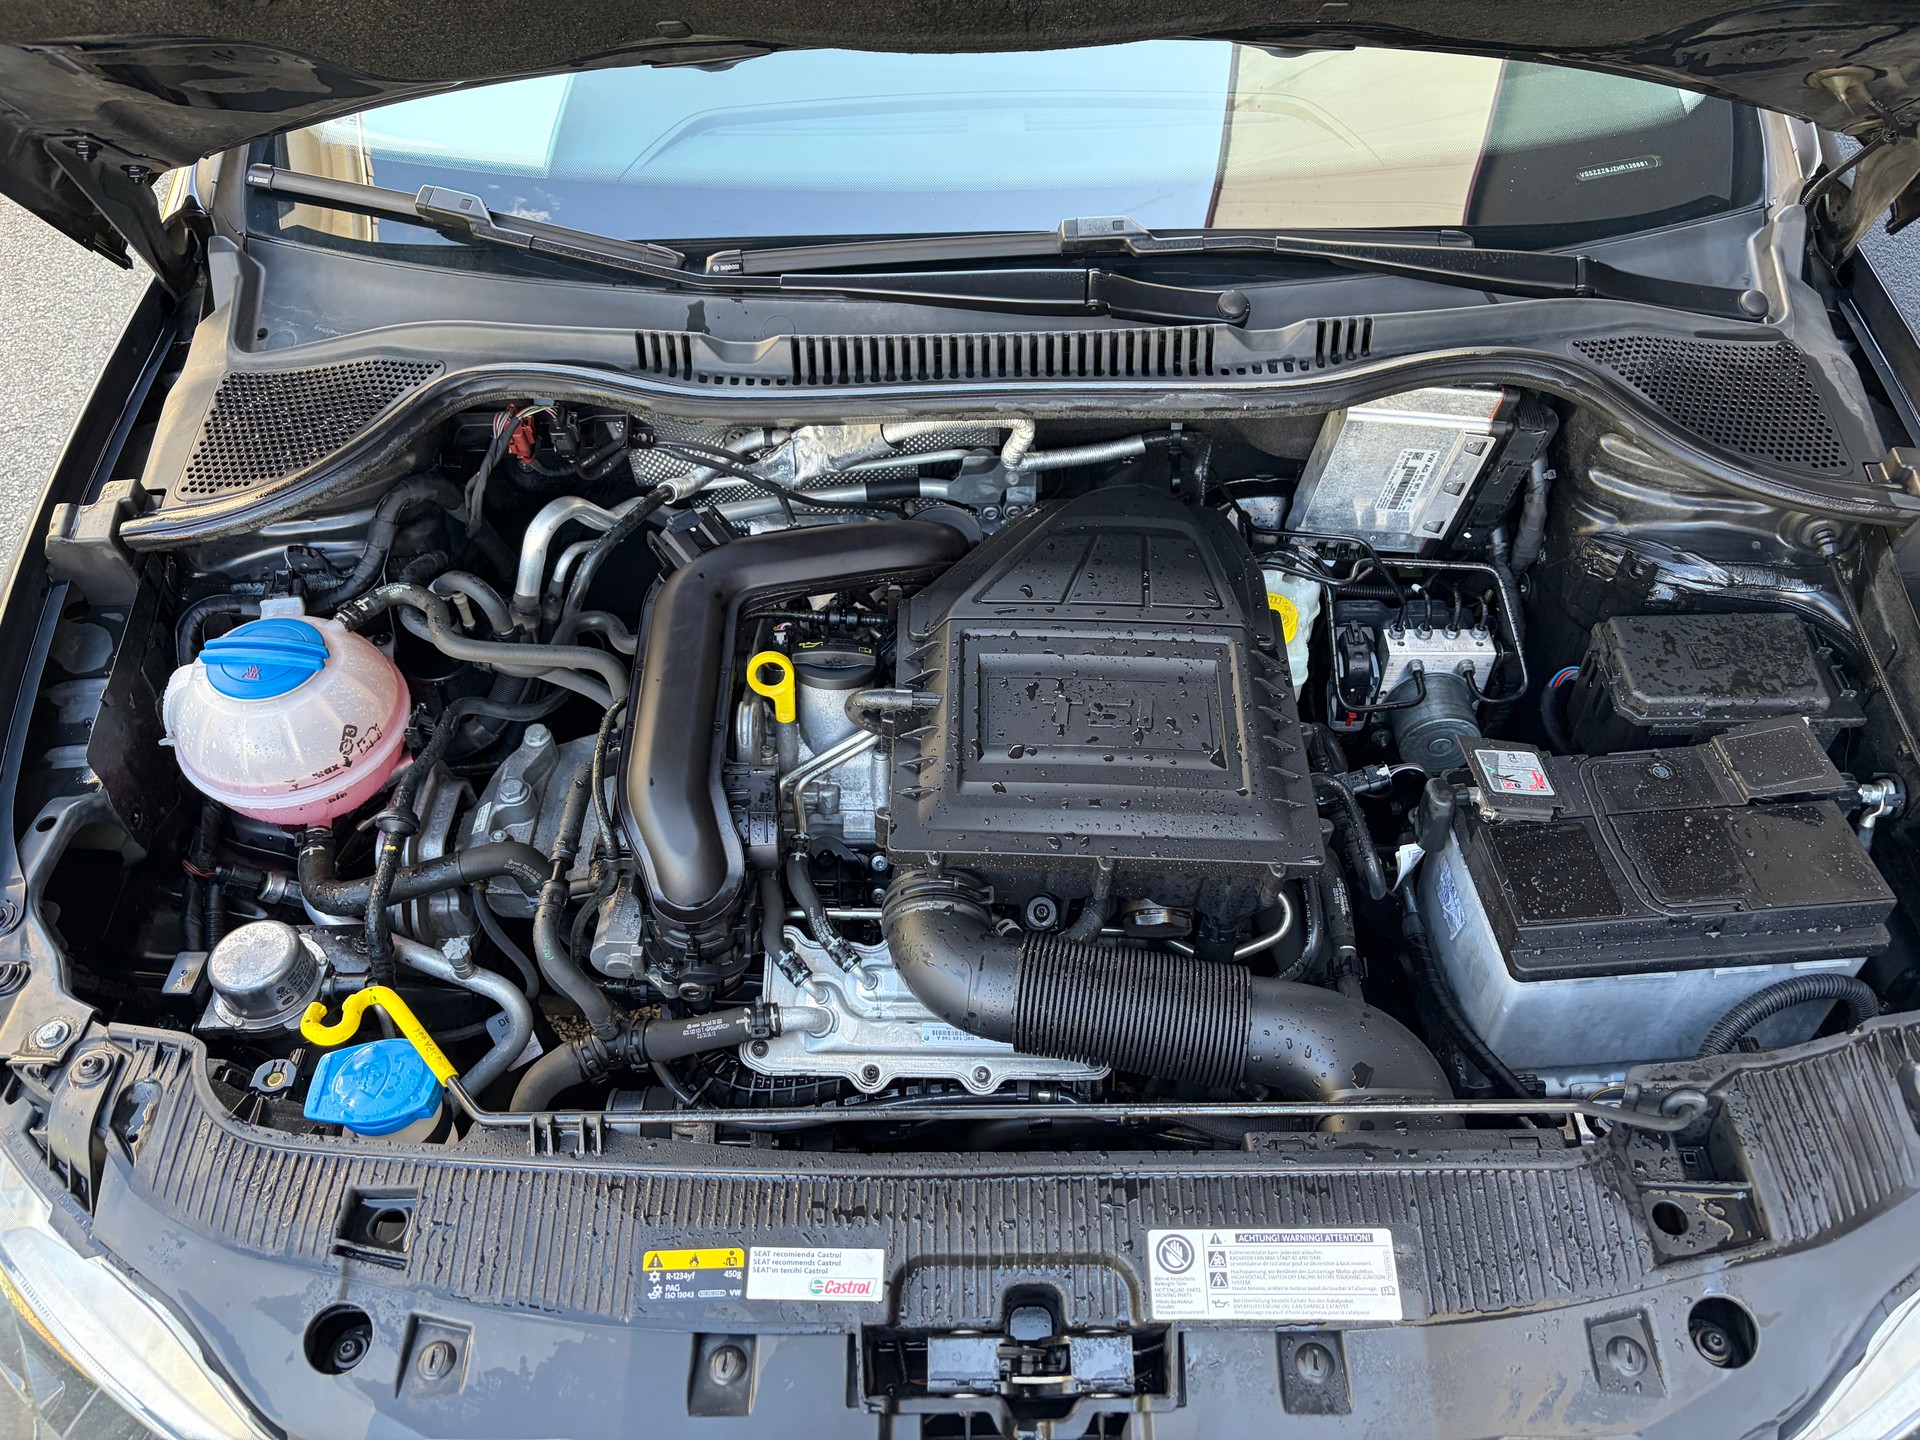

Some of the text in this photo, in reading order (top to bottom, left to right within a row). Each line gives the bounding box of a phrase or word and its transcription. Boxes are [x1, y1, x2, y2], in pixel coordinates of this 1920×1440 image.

[1041, 694, 1154, 728] TSI
[1238, 1233, 1371, 1242] ACHTUNG! WARNING! ATTENTION!
[818, 1251, 842, 1259] Castrol
[665, 1270, 742, 1282] R-1234yf 450g
[665, 1284, 680, 1292] PAG
[824, 1280, 871, 1294] Castrol
